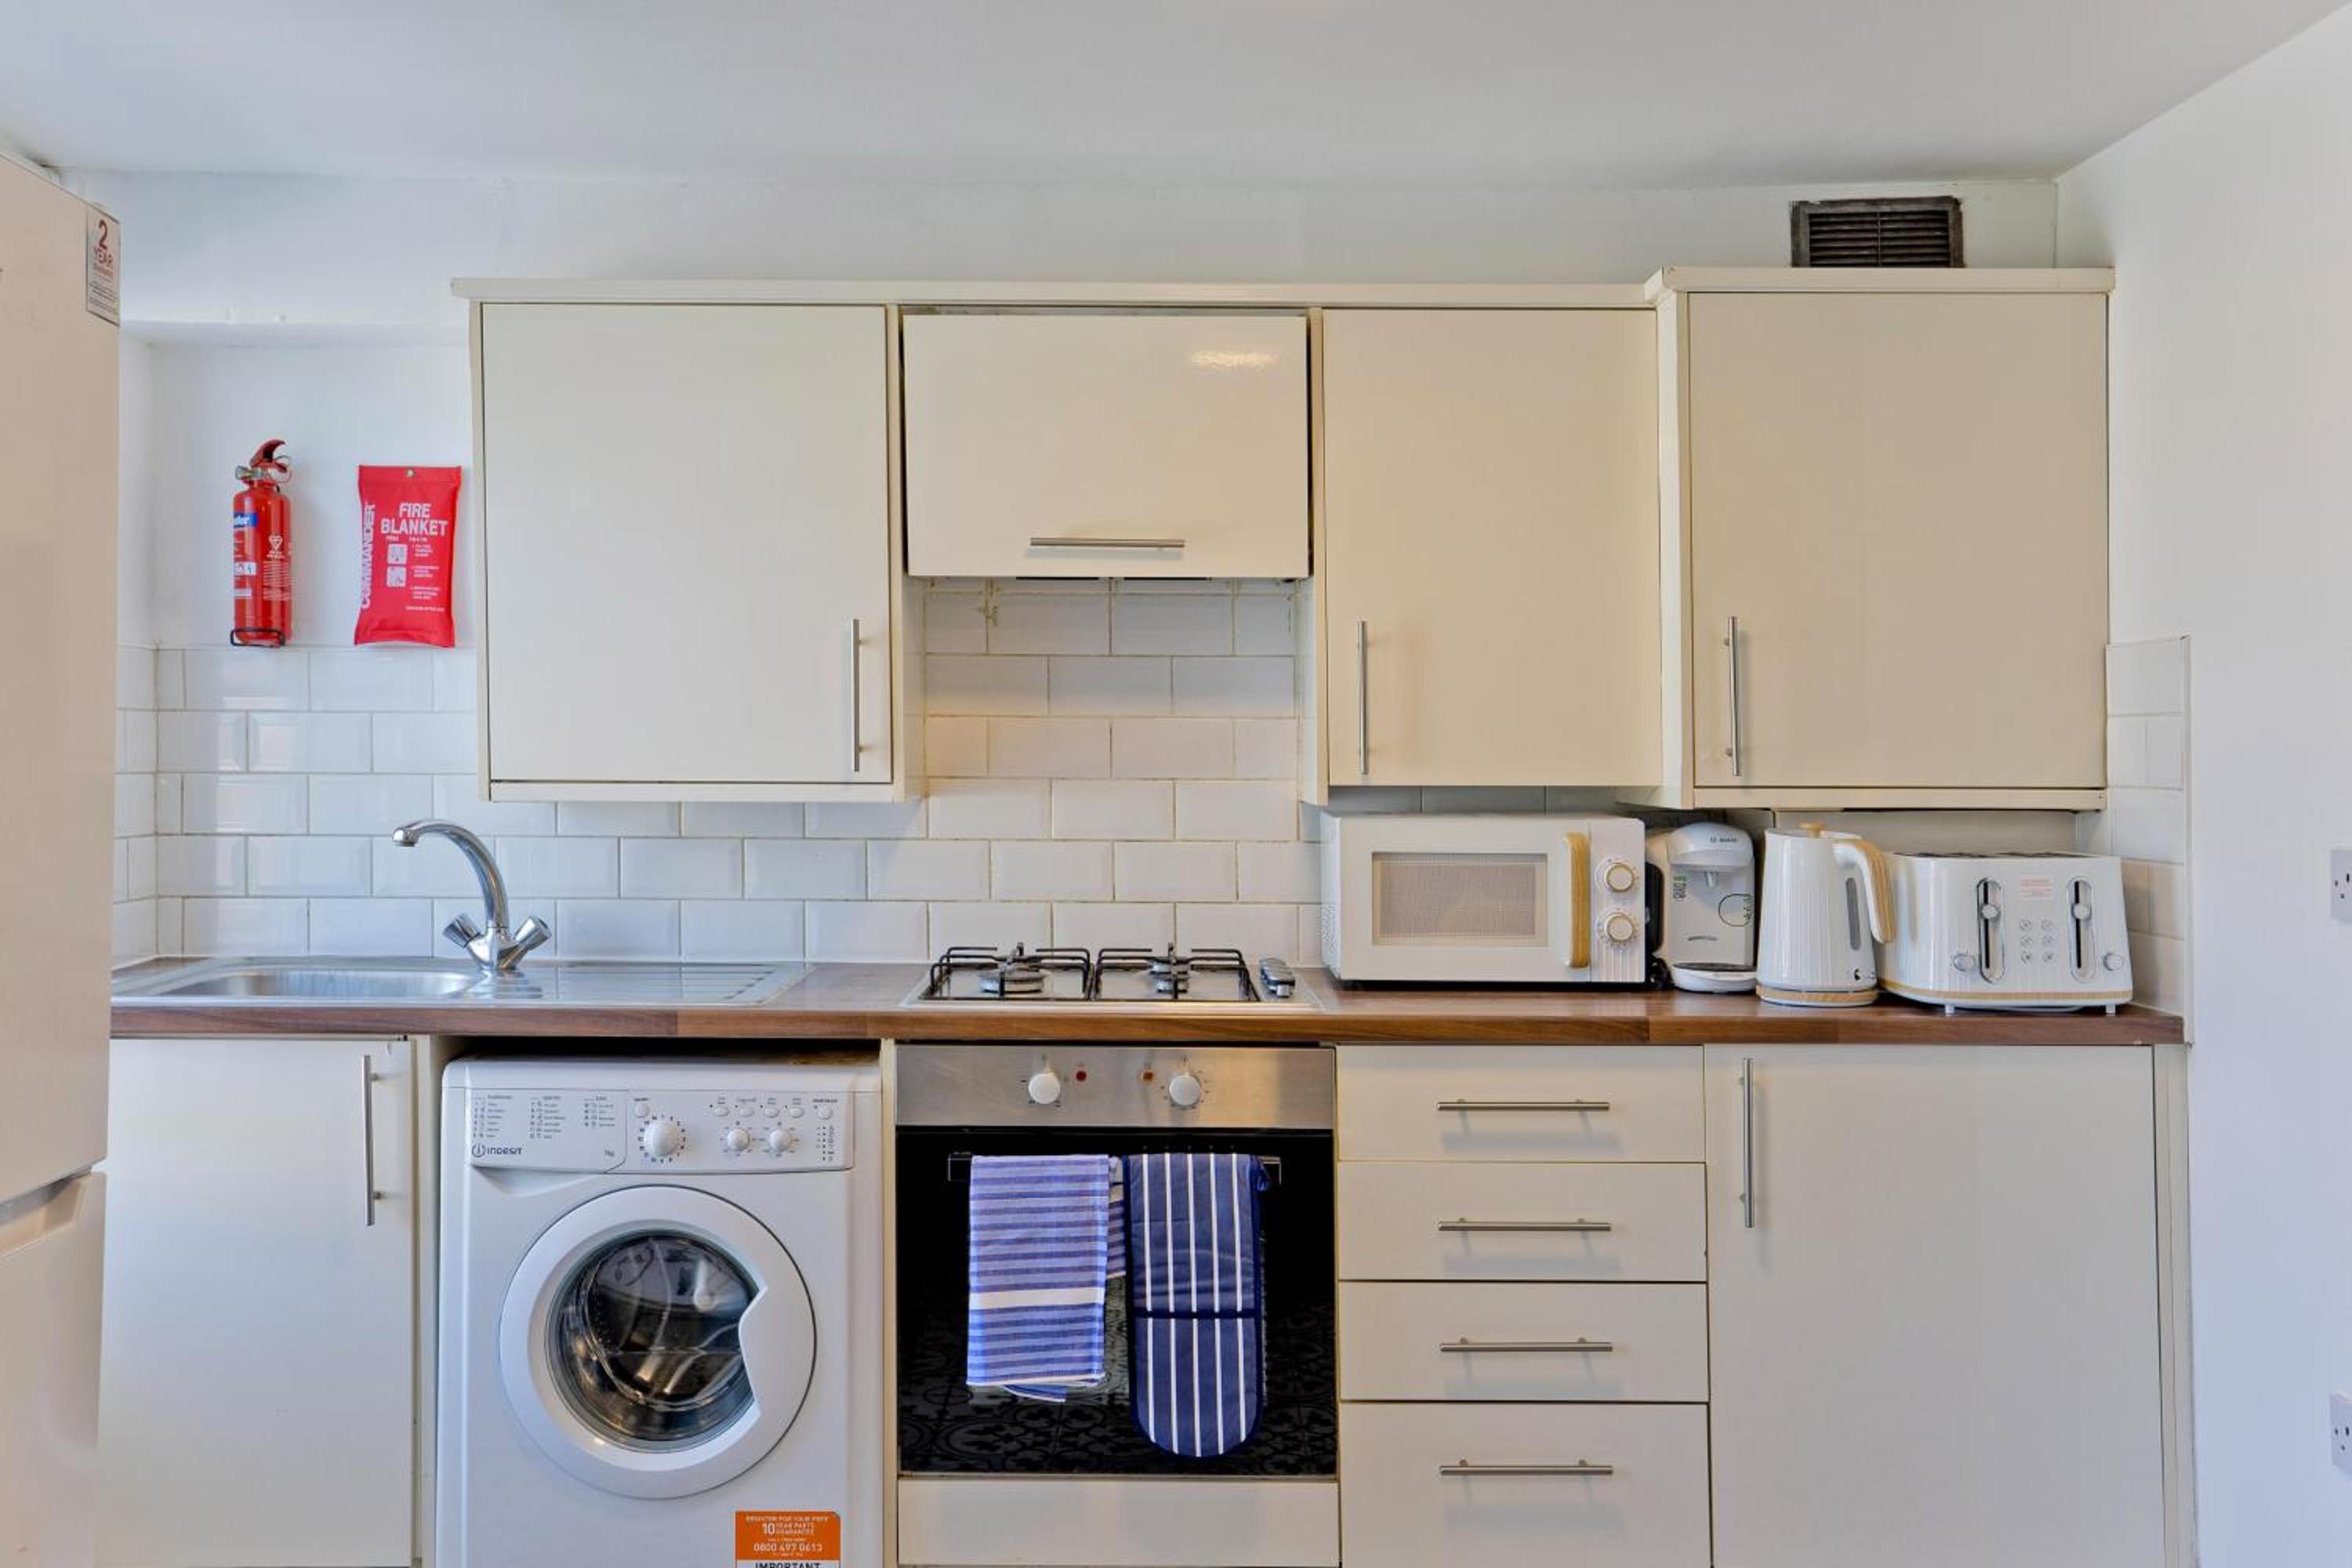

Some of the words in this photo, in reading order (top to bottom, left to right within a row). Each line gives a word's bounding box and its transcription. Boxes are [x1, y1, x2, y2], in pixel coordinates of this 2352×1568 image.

[99, 220, 107, 249] 2
[399, 502, 432, 518] FIRE
[381, 518, 449, 536] BLANKET
[762, 1523, 775, 1535] 10
[753, 1543, 777, 1552] 0800
[779, 1543, 797, 1552] 497
[799, 1543, 822, 1552] 0613
